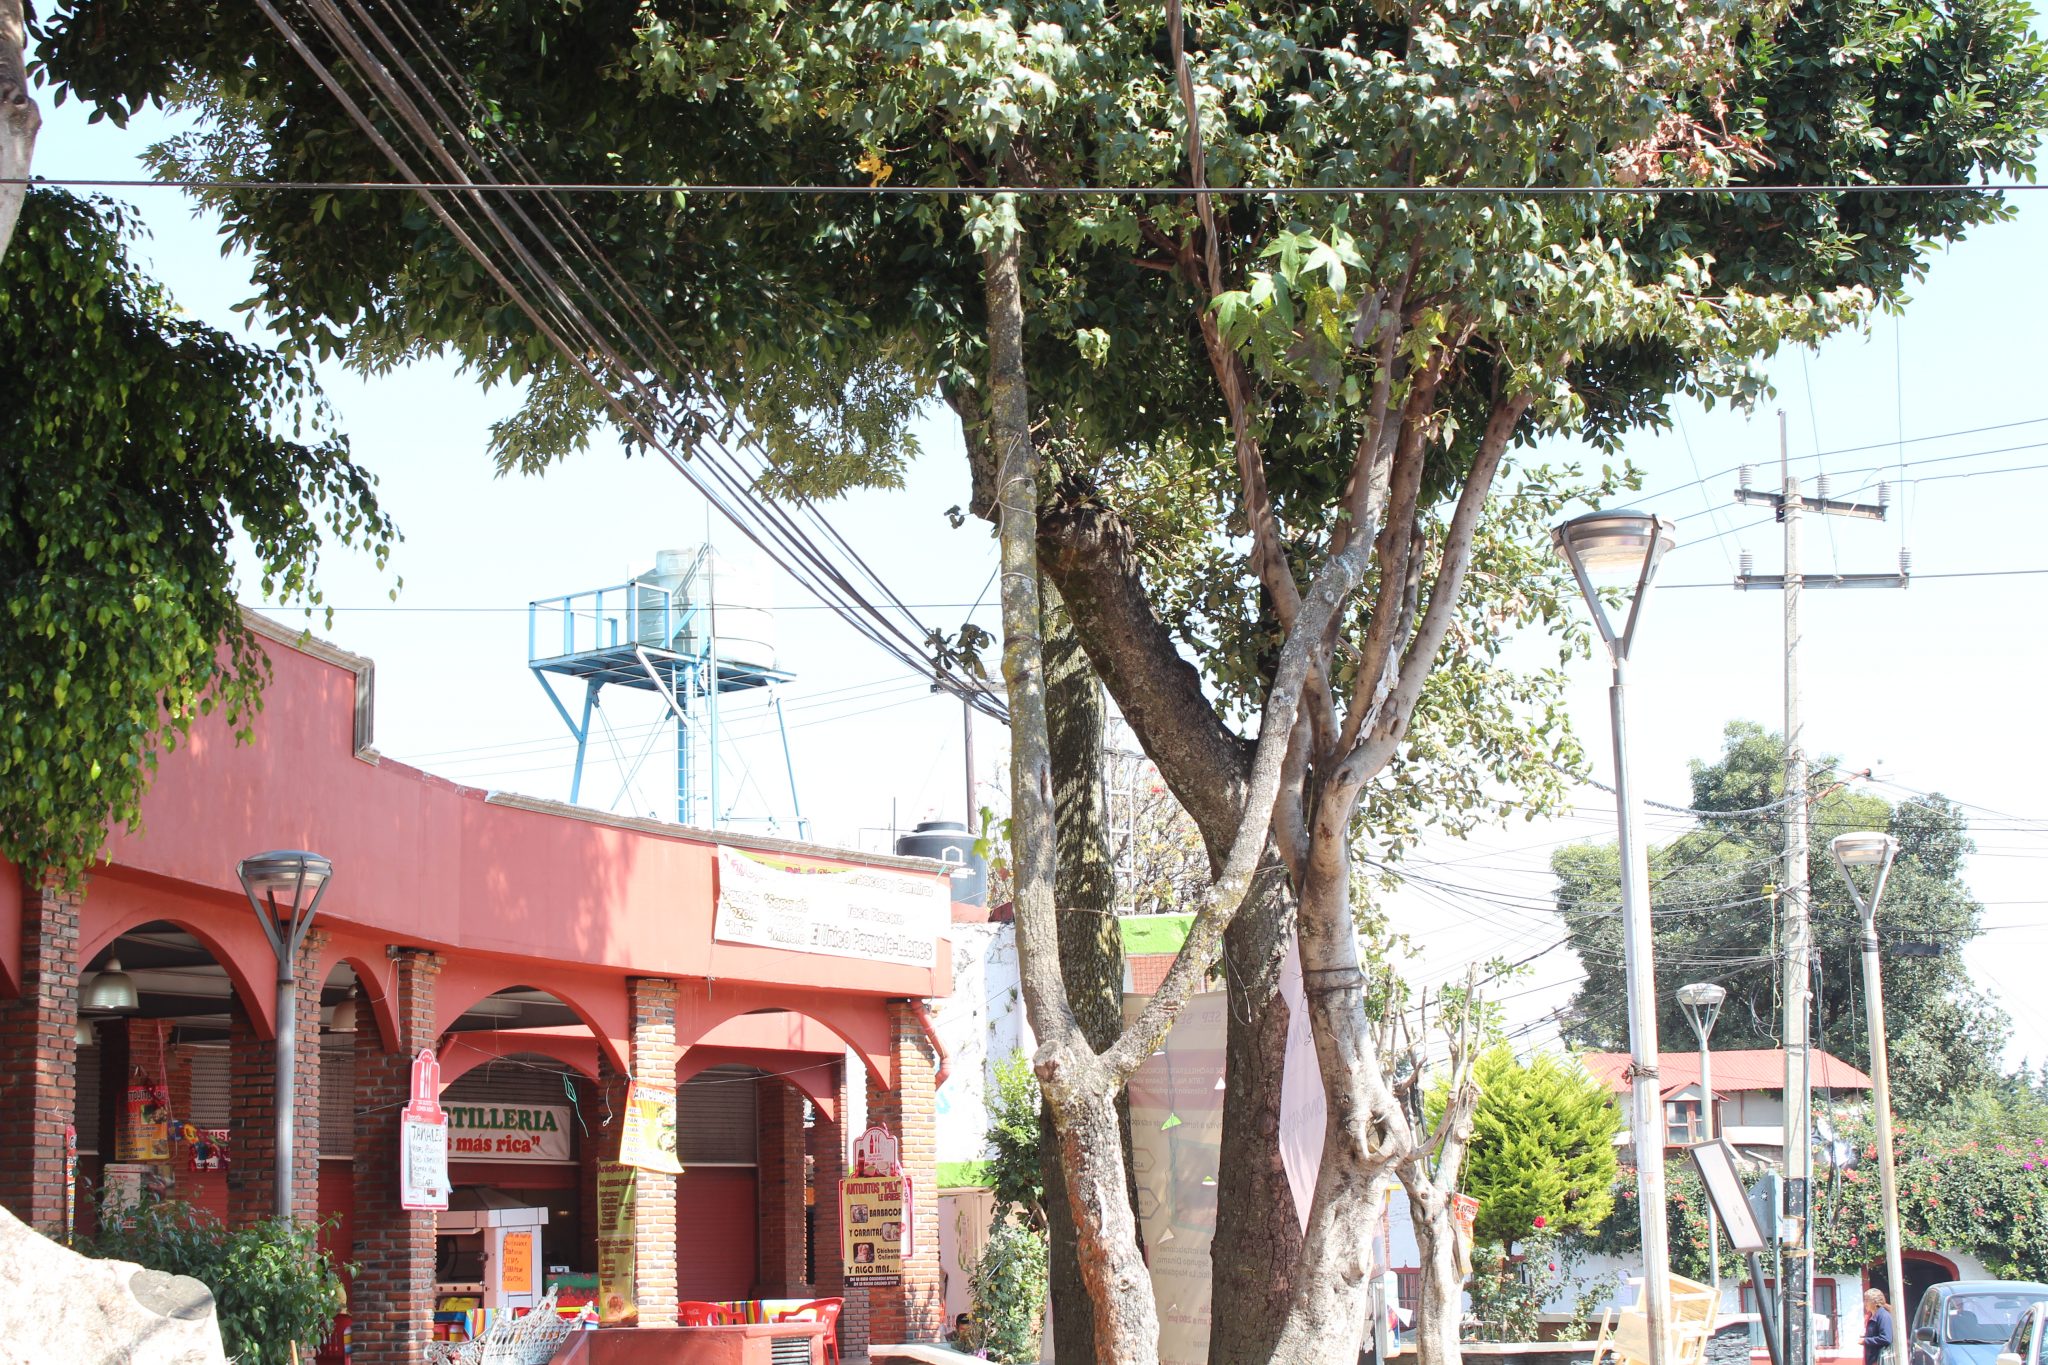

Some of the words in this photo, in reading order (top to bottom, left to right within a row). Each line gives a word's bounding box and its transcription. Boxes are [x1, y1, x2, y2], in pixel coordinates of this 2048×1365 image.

[456, 1134, 492, 1152] más
[846, 1182, 880, 1195] ANTOJITOS
[869, 1208, 902, 1218] BARBACOA
[848, 1266, 853, 1275] Y
[855, 1265, 874, 1275] ALGO
